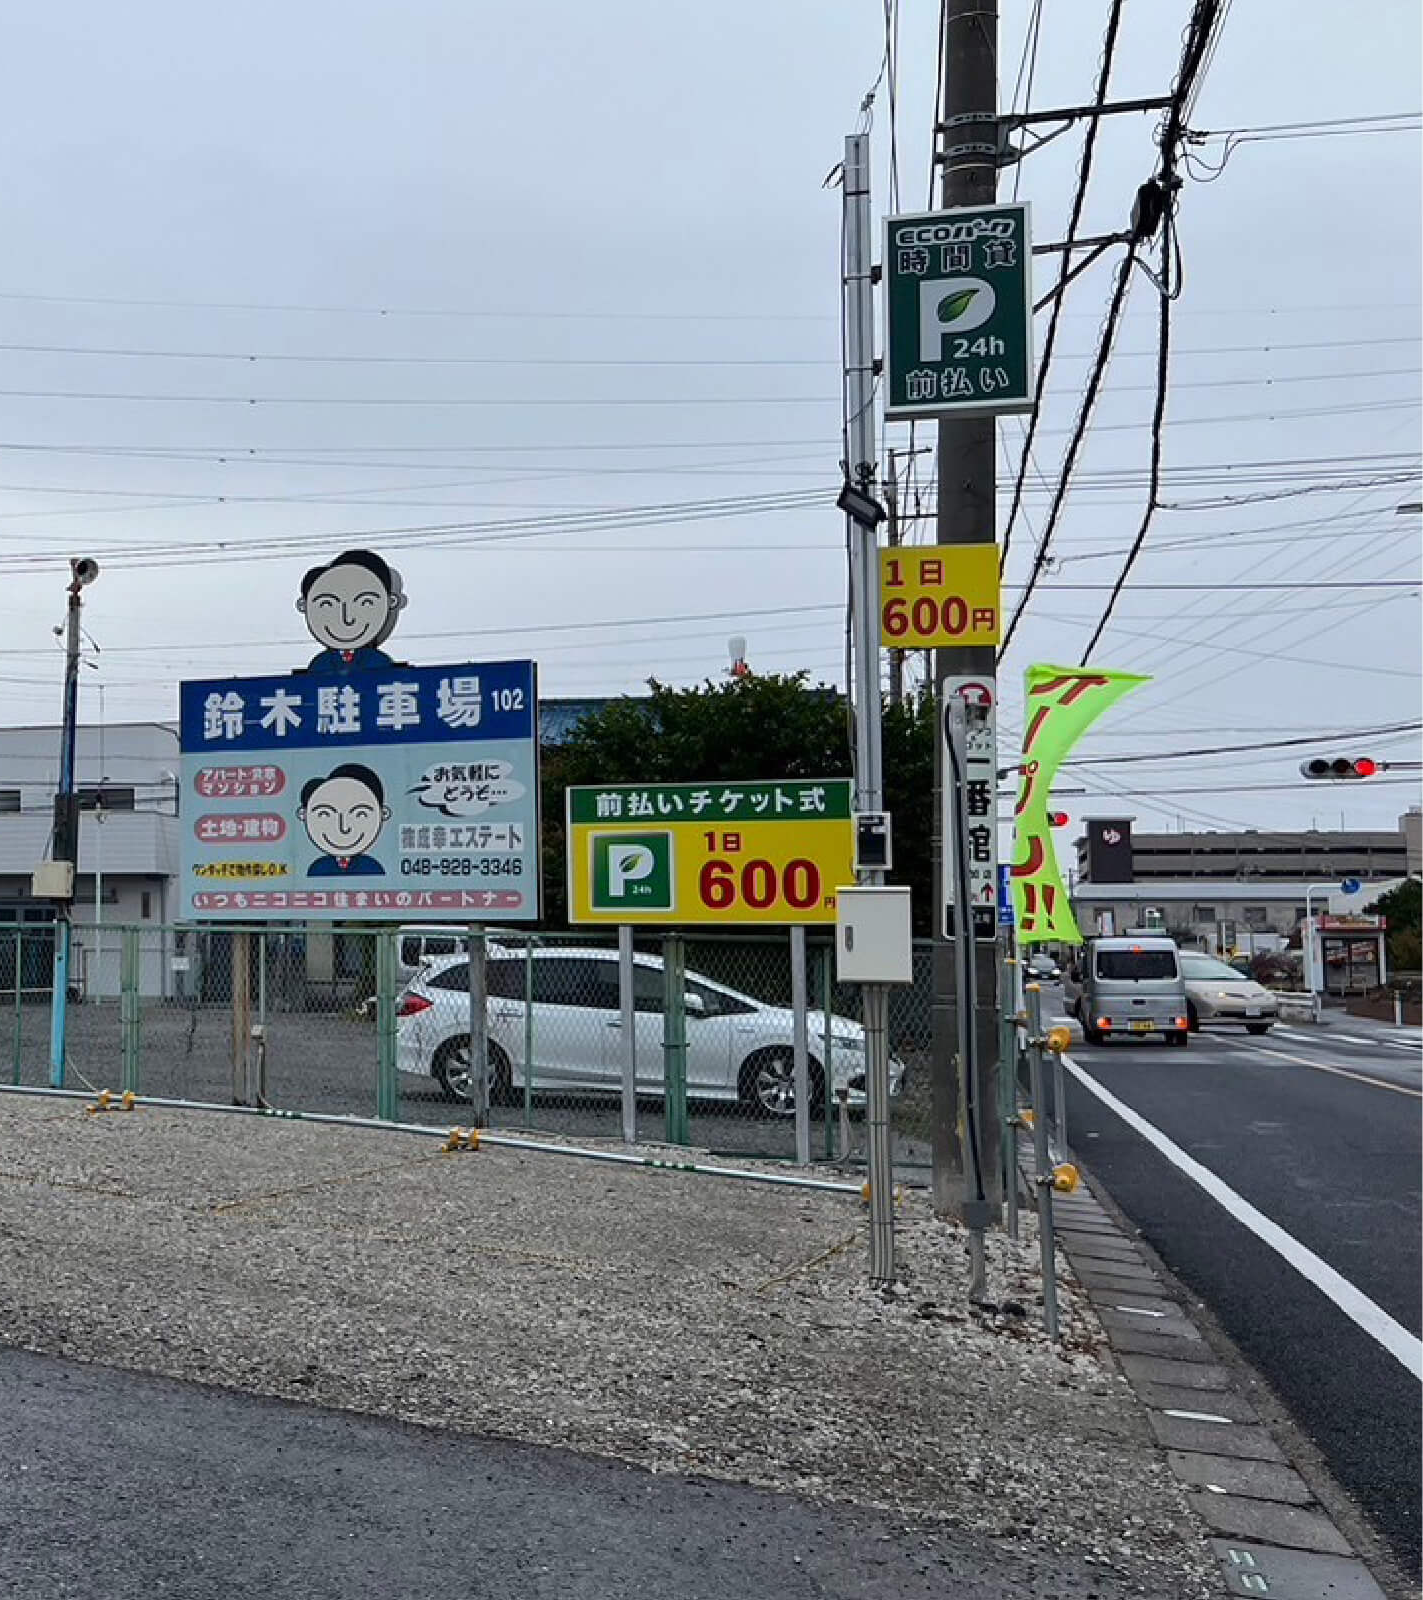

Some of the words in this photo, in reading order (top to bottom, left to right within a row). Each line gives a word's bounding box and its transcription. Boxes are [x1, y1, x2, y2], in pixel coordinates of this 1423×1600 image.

[897, 239, 1017, 275] 時間貸
[919, 278, 996, 362] P
[953, 336, 1005, 359] 24h
[905, 367, 1010, 399] 前払い
[882, 595, 996, 637] 600円
[203, 675, 482, 739] 鈴木駐車場
[490, 688, 525, 712] 102
[596, 787, 826, 818] 前払いチケット式
[703, 831, 741, 852] 1日
[608, 843, 655, 898] P
[193, 890, 521, 909] いつもニコニコ住まいのパートナー
